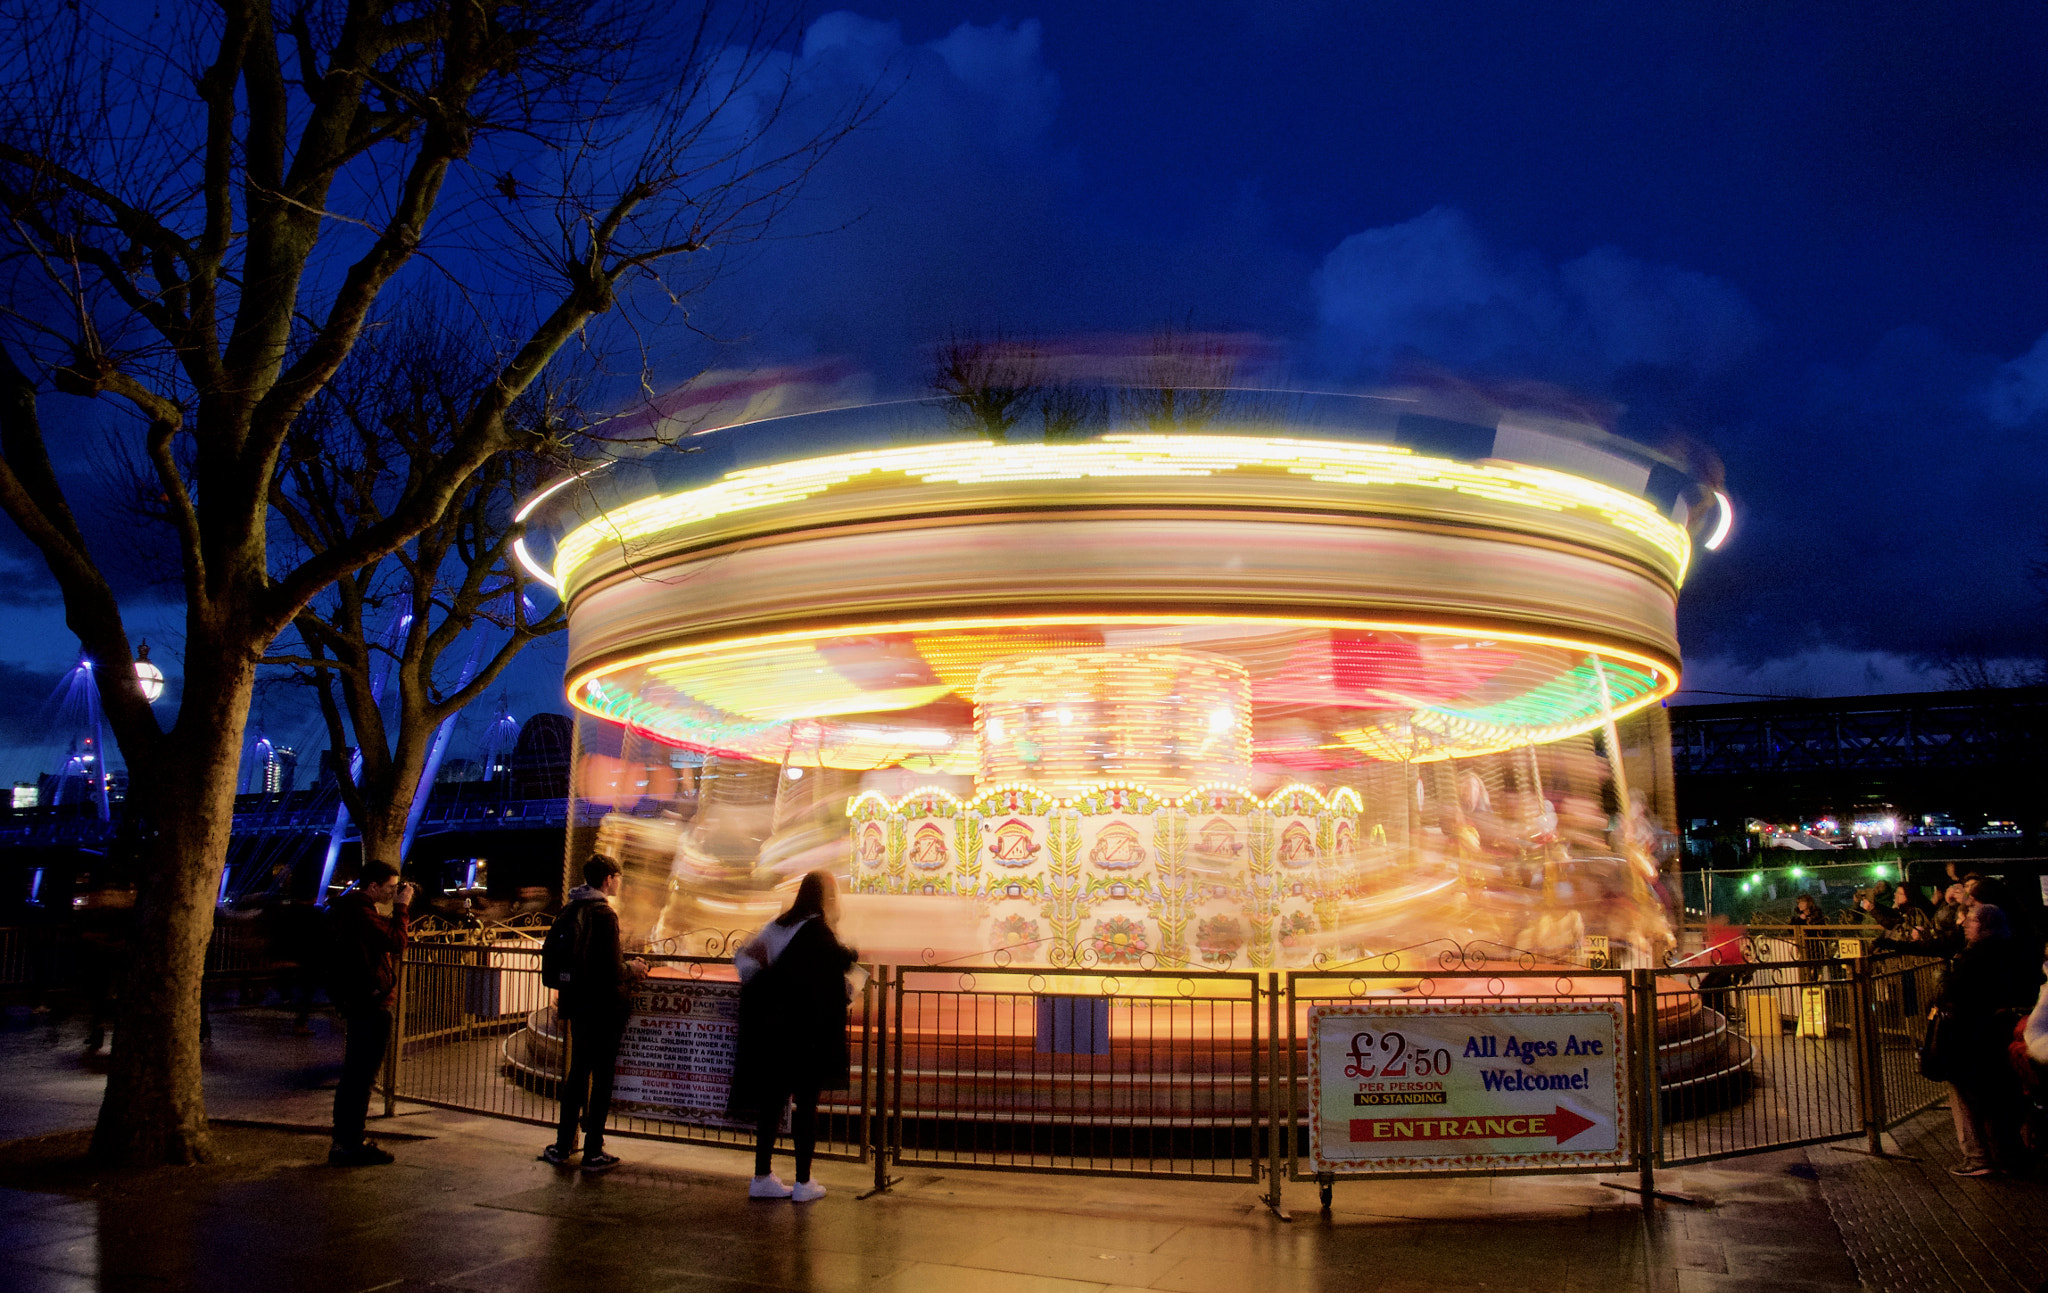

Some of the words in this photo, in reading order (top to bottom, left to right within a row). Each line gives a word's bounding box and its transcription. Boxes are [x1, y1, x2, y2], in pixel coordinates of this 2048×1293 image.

[1840, 942, 1859, 955] EXIT
[650, 994, 692, 1014] £2.50
[629, 1027, 662, 1036] STANDING
[640, 1019, 693, 1030] SAFETY
[697, 1023, 740, 1034] NOTIC
[624, 1034, 636, 1042] ALL
[660, 1038, 694, 1047] CHILDREN
[632, 1052, 663, 1060] CHILDREN
[641, 1045, 688, 1054] ACCOMPANIED
[1462, 1035, 1498, 1058] All
[1503, 1035, 1558, 1065] Ages
[1563, 1034, 1604, 1056] Are
[623, 1059, 655, 1068] CHILDREN
[676, 1063, 692, 1071] RIDE
[709, 1067, 732, 1075] INSIDE
[1480, 1067, 1590, 1092] Welcome!
[642, 1080, 670, 1088] SECURE
[671, 1082, 691, 1090] YOUR
[692, 1084, 731, 1094] VALUABLE
[1359, 1082, 1385, 1092] PER
[1389, 1081, 1443, 1091] PERSON
[663, 1090, 698, 1099] RESPONSIBLE
[1359, 1094, 1380, 1105] NO
[1382, 1092, 1443, 1104] STANDING
[1372, 1118, 1547, 1138] ENTRANCE
